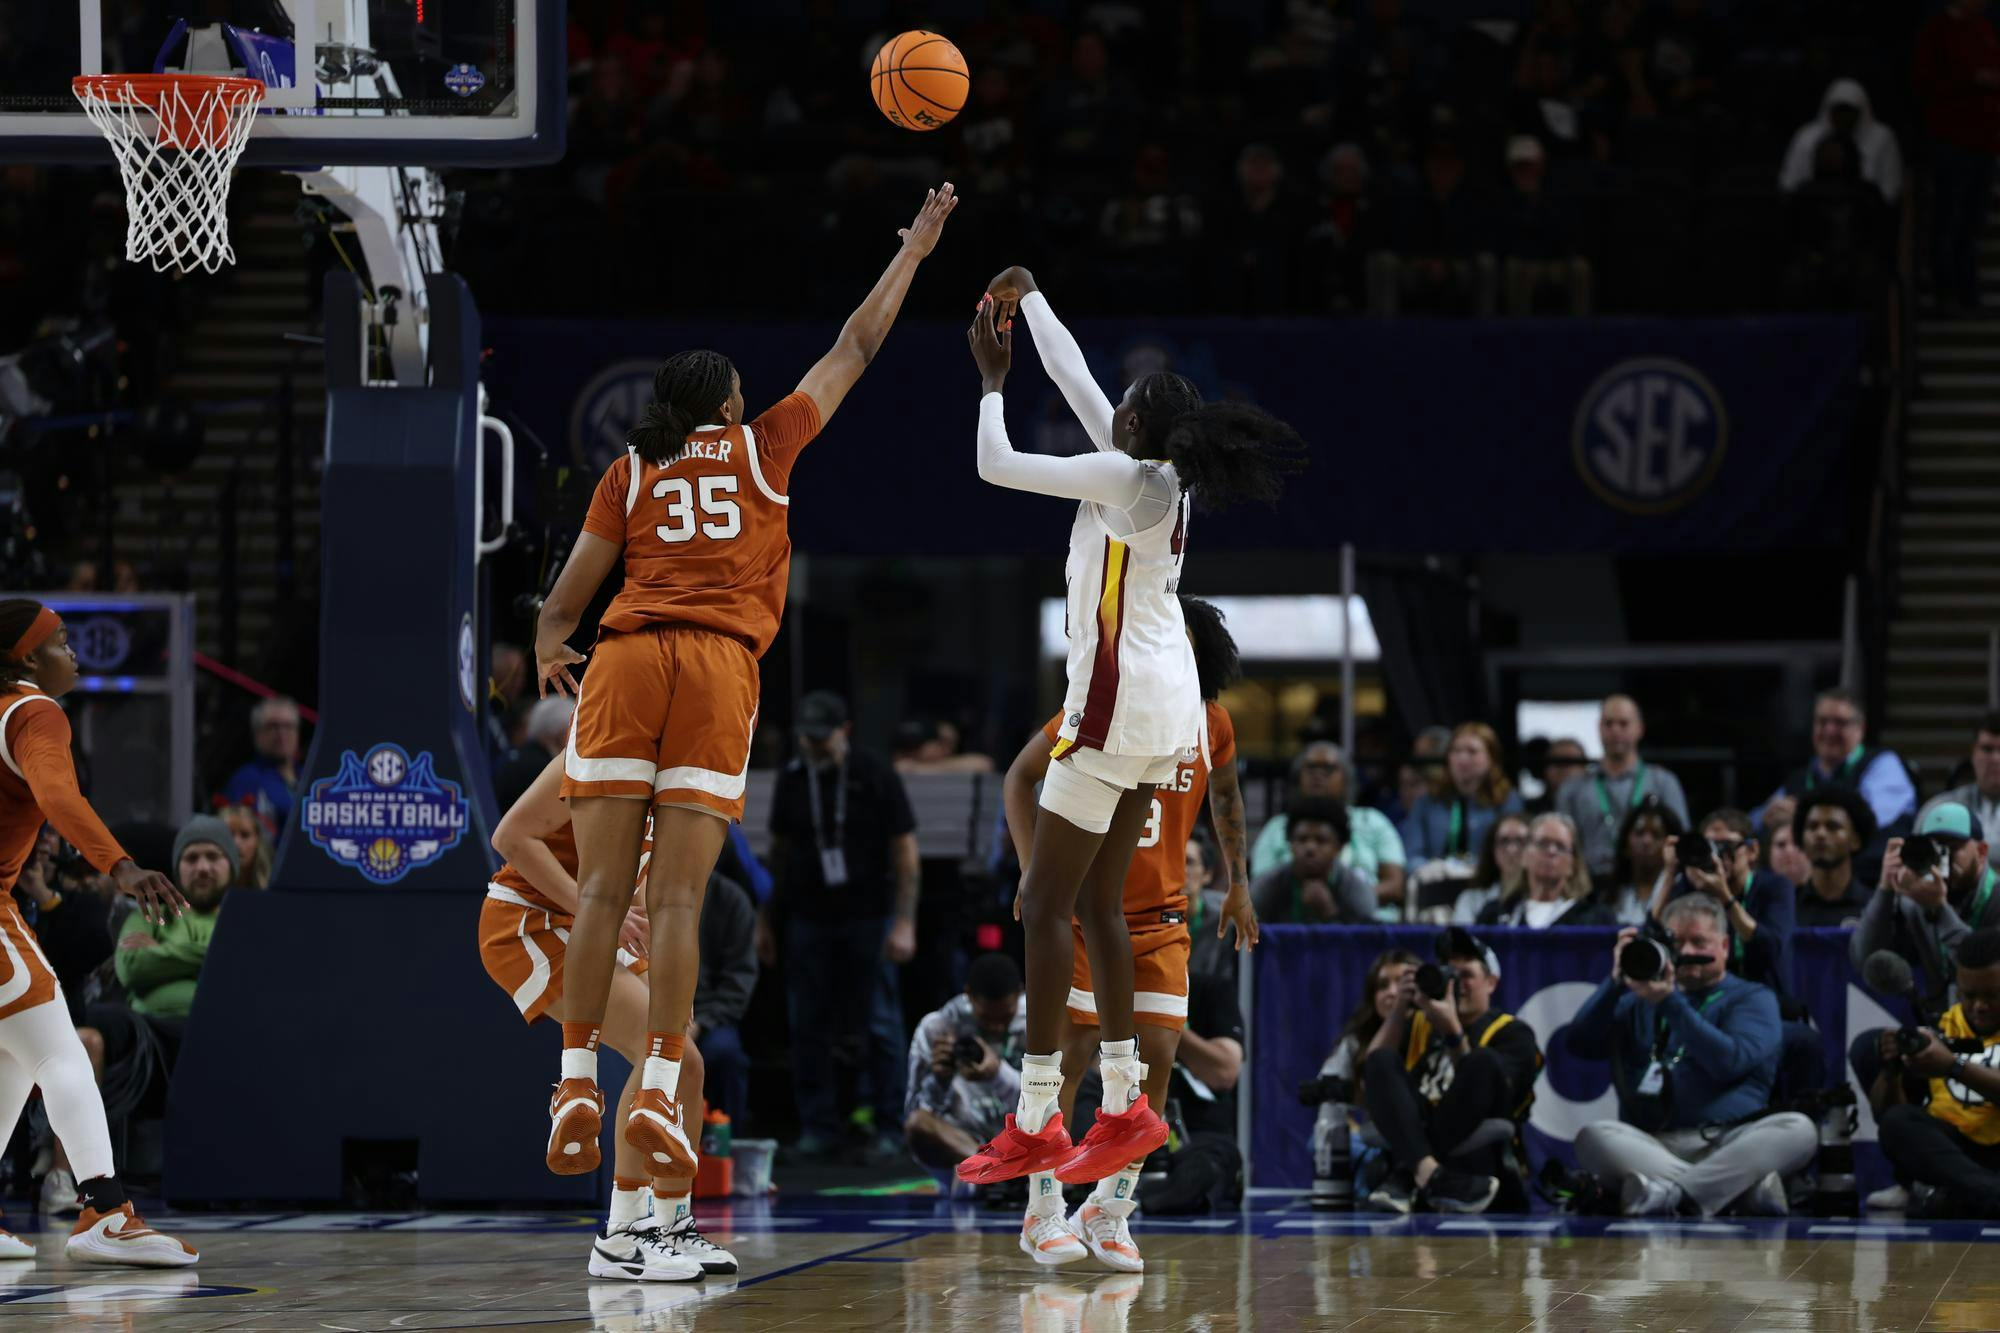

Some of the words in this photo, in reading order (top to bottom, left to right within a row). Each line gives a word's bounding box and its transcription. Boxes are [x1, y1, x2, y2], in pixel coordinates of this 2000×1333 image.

[1591, 375, 1708, 496] SEC
[653, 475, 741, 542] 35
[371, 750, 402, 785] SEC
[308, 801, 464, 827] BASKETBALL
[348, 792, 424, 802] WOMEN'S
